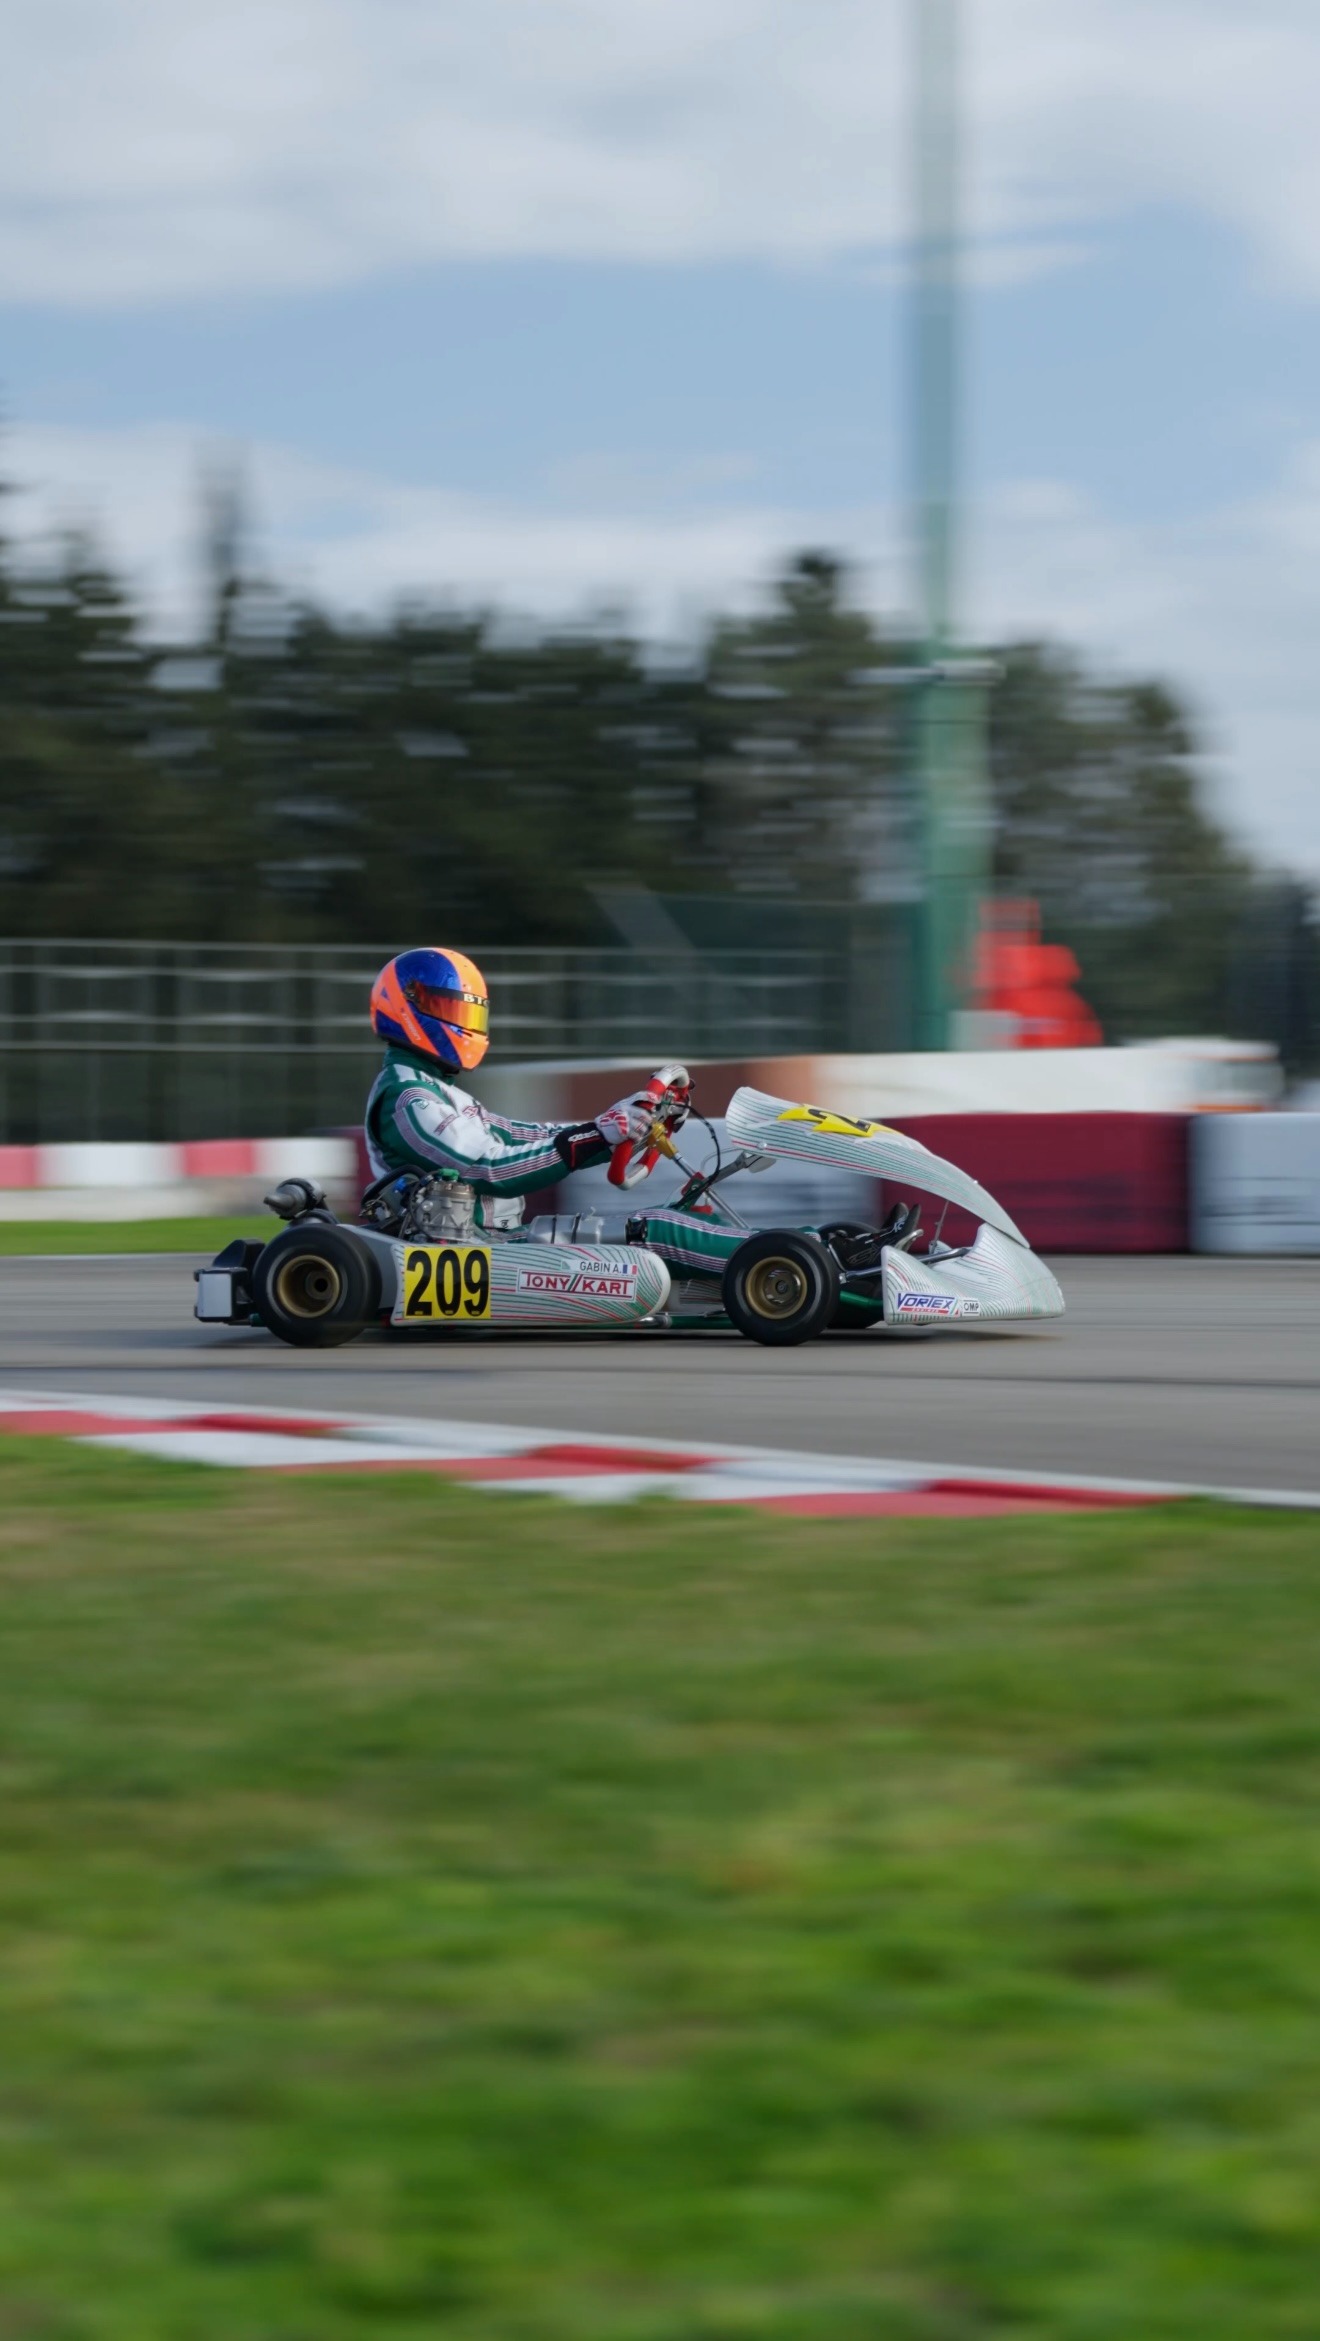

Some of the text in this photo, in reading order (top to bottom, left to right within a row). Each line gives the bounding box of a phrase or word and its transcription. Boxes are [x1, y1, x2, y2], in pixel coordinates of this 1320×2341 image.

[580, 1261, 622, 1273] GABIN A.
[406, 1249, 489, 1316] 209
[898, 1293, 955, 1309] VORTEX
[963, 1302, 980, 1312] OMP
